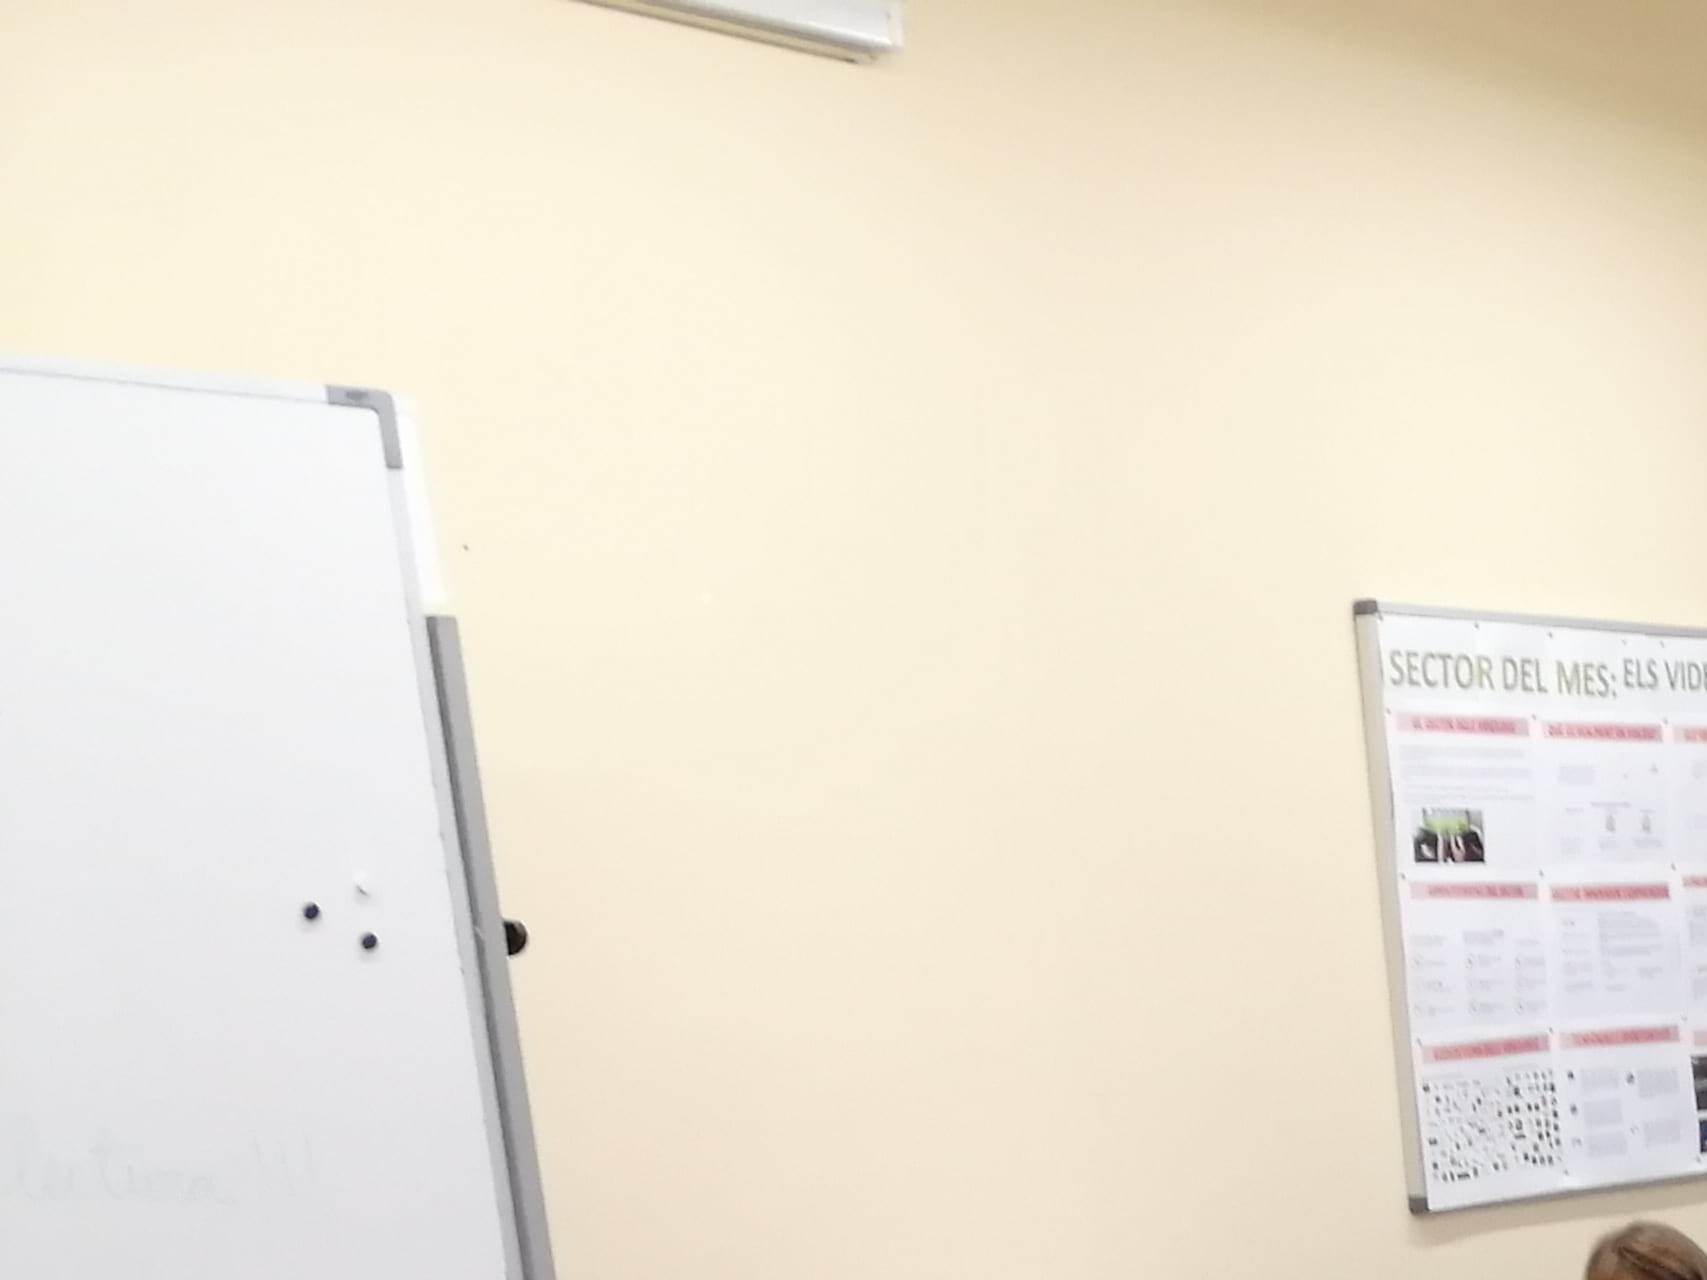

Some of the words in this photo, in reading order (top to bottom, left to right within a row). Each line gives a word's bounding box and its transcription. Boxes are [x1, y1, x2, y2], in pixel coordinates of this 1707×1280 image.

[1389, 649, 1496, 691] SECTOR
[1501, 656, 1548, 694] DEL
[1556, 659, 1618, 699] MES:
[1622, 656, 1660, 689] ELS
